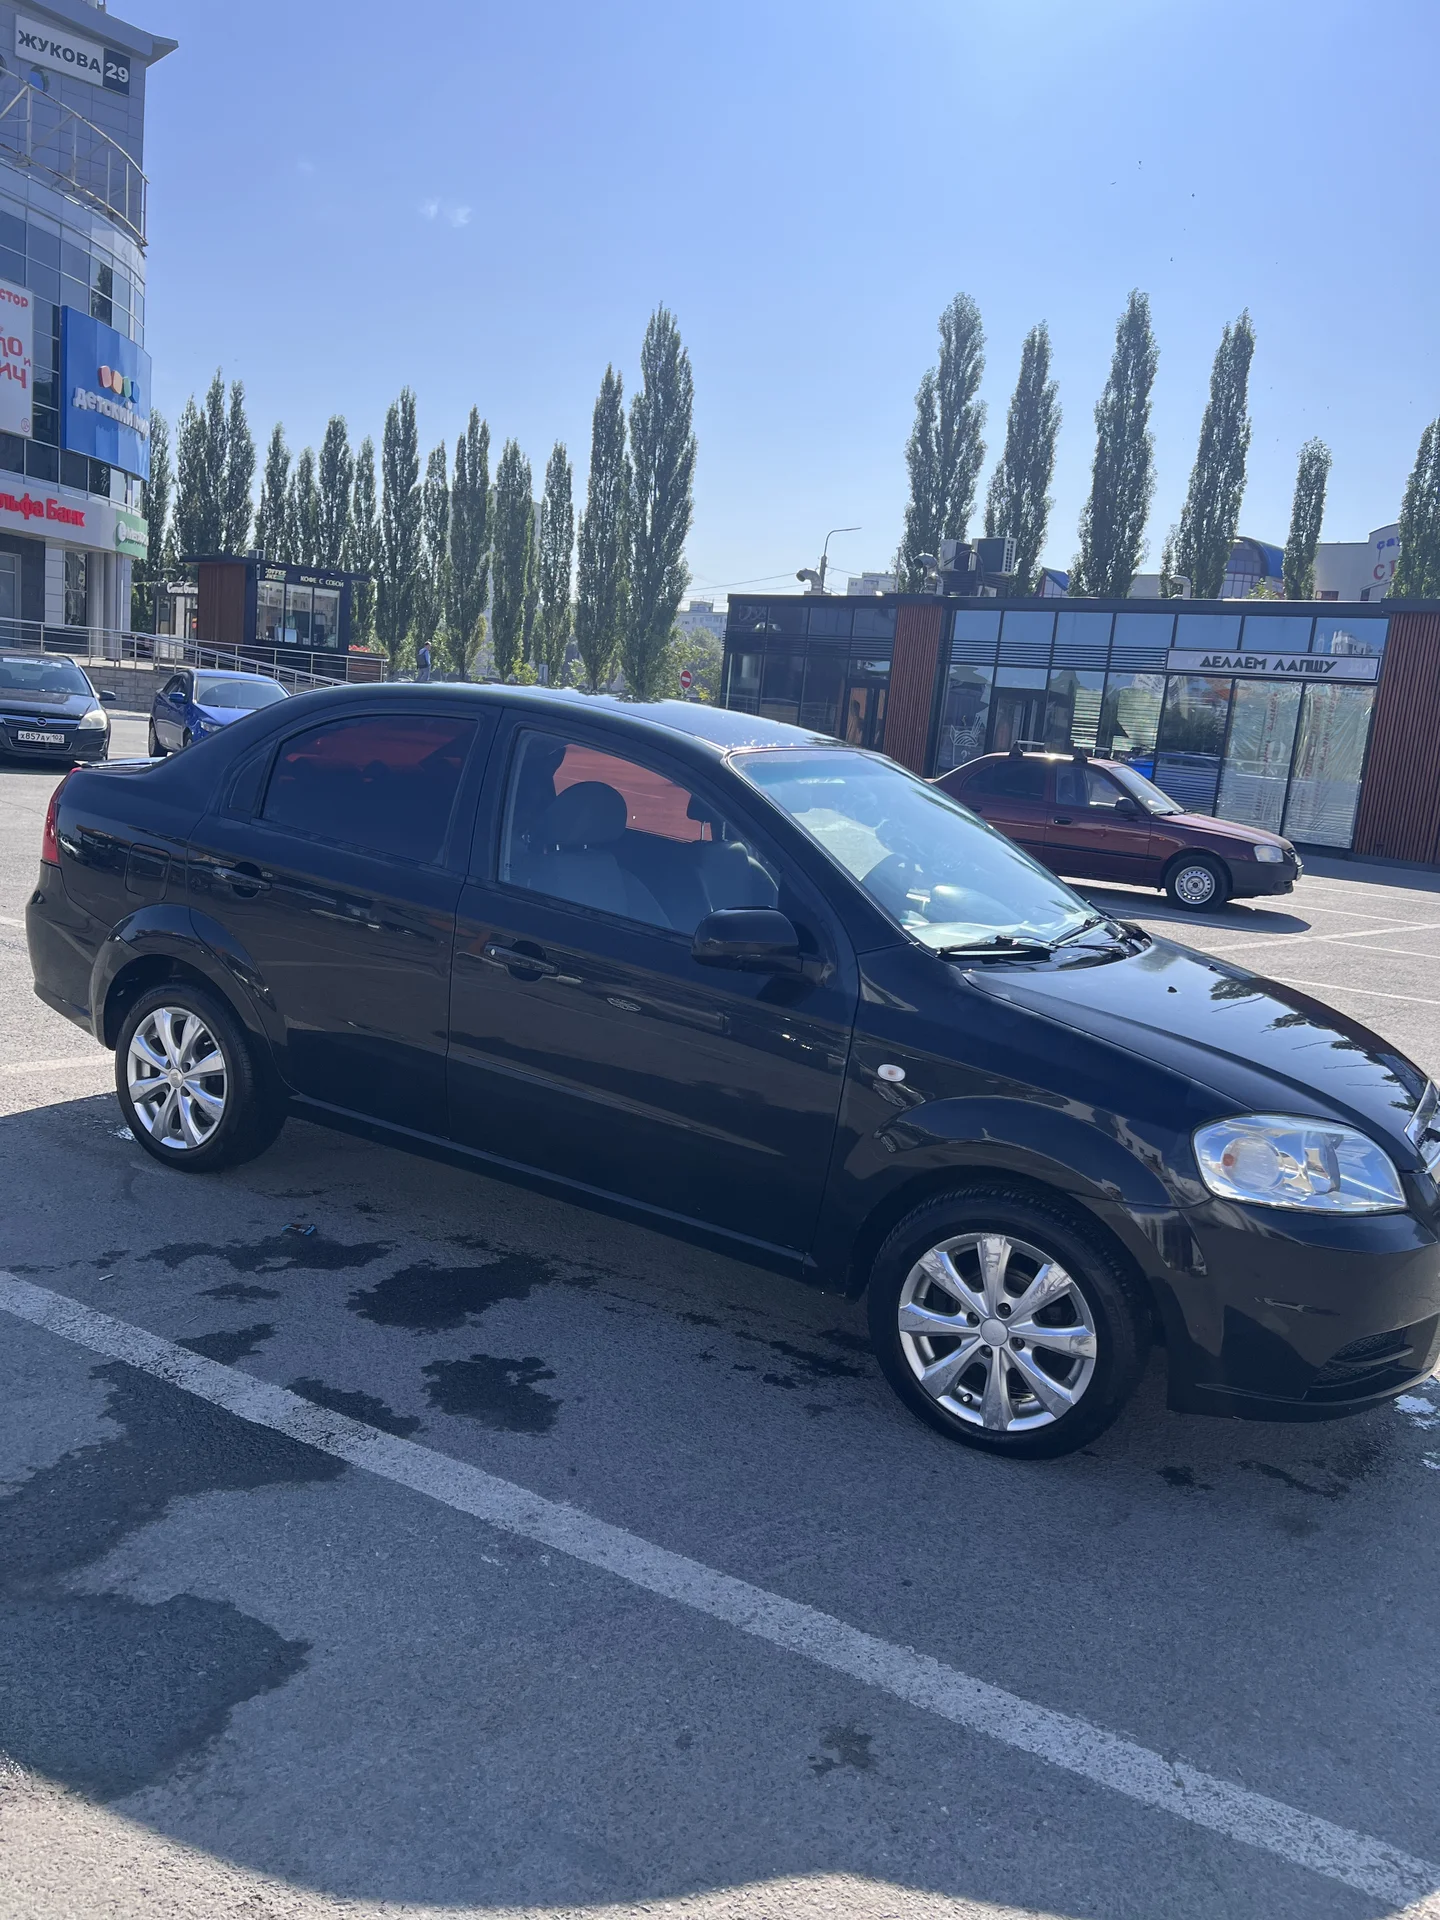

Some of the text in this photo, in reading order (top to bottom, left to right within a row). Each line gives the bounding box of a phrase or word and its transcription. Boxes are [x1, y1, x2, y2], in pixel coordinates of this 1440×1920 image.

[18, 30, 129, 83] ЖУКОВА 29
[46, 498, 85, 527] Банк
[300, 575, 317, 584] КОФЕ
[1200, 656, 1267, 670] ДЕЛАЕМ
[1273, 659, 1338, 673] ЛАПШУ
